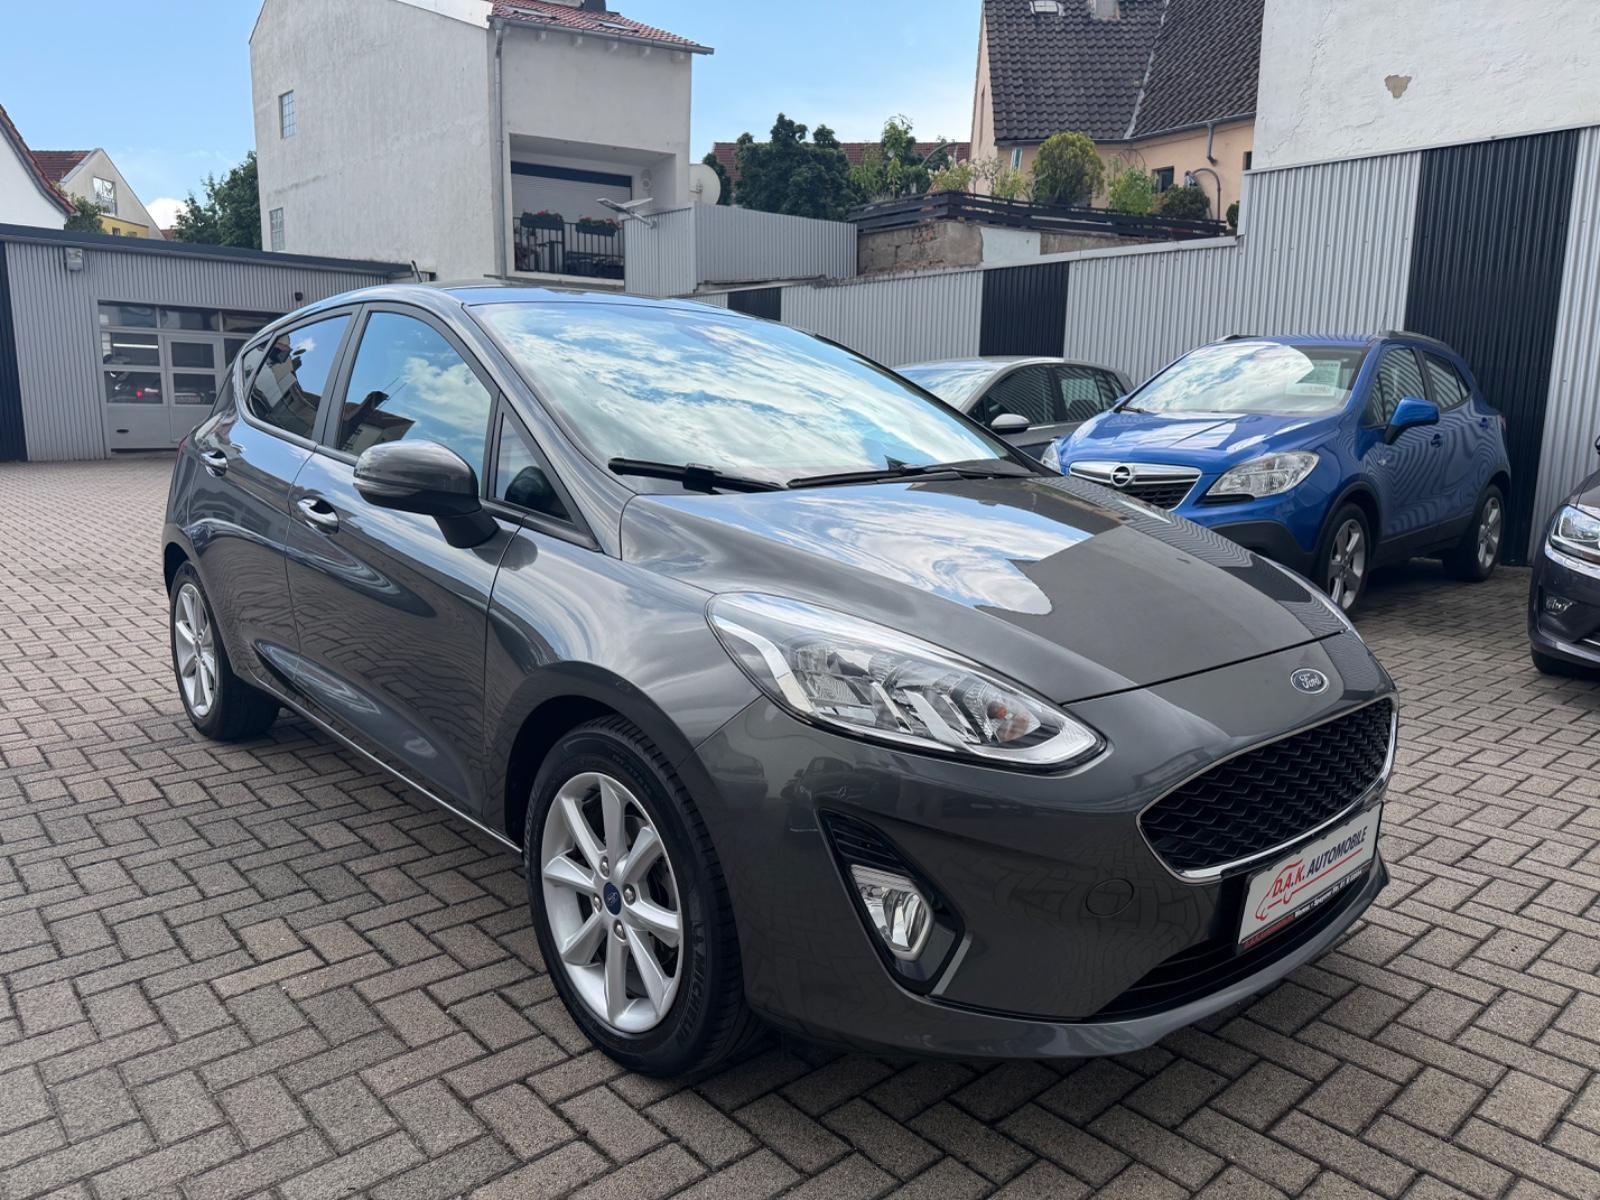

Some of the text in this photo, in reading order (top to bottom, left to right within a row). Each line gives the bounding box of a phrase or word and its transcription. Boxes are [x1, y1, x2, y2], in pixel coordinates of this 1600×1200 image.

[1298, 673, 1322, 689] Ford
[1272, 864, 1305, 898] D.A.K.
[1306, 826, 1368, 878] AUTOMOBILE
